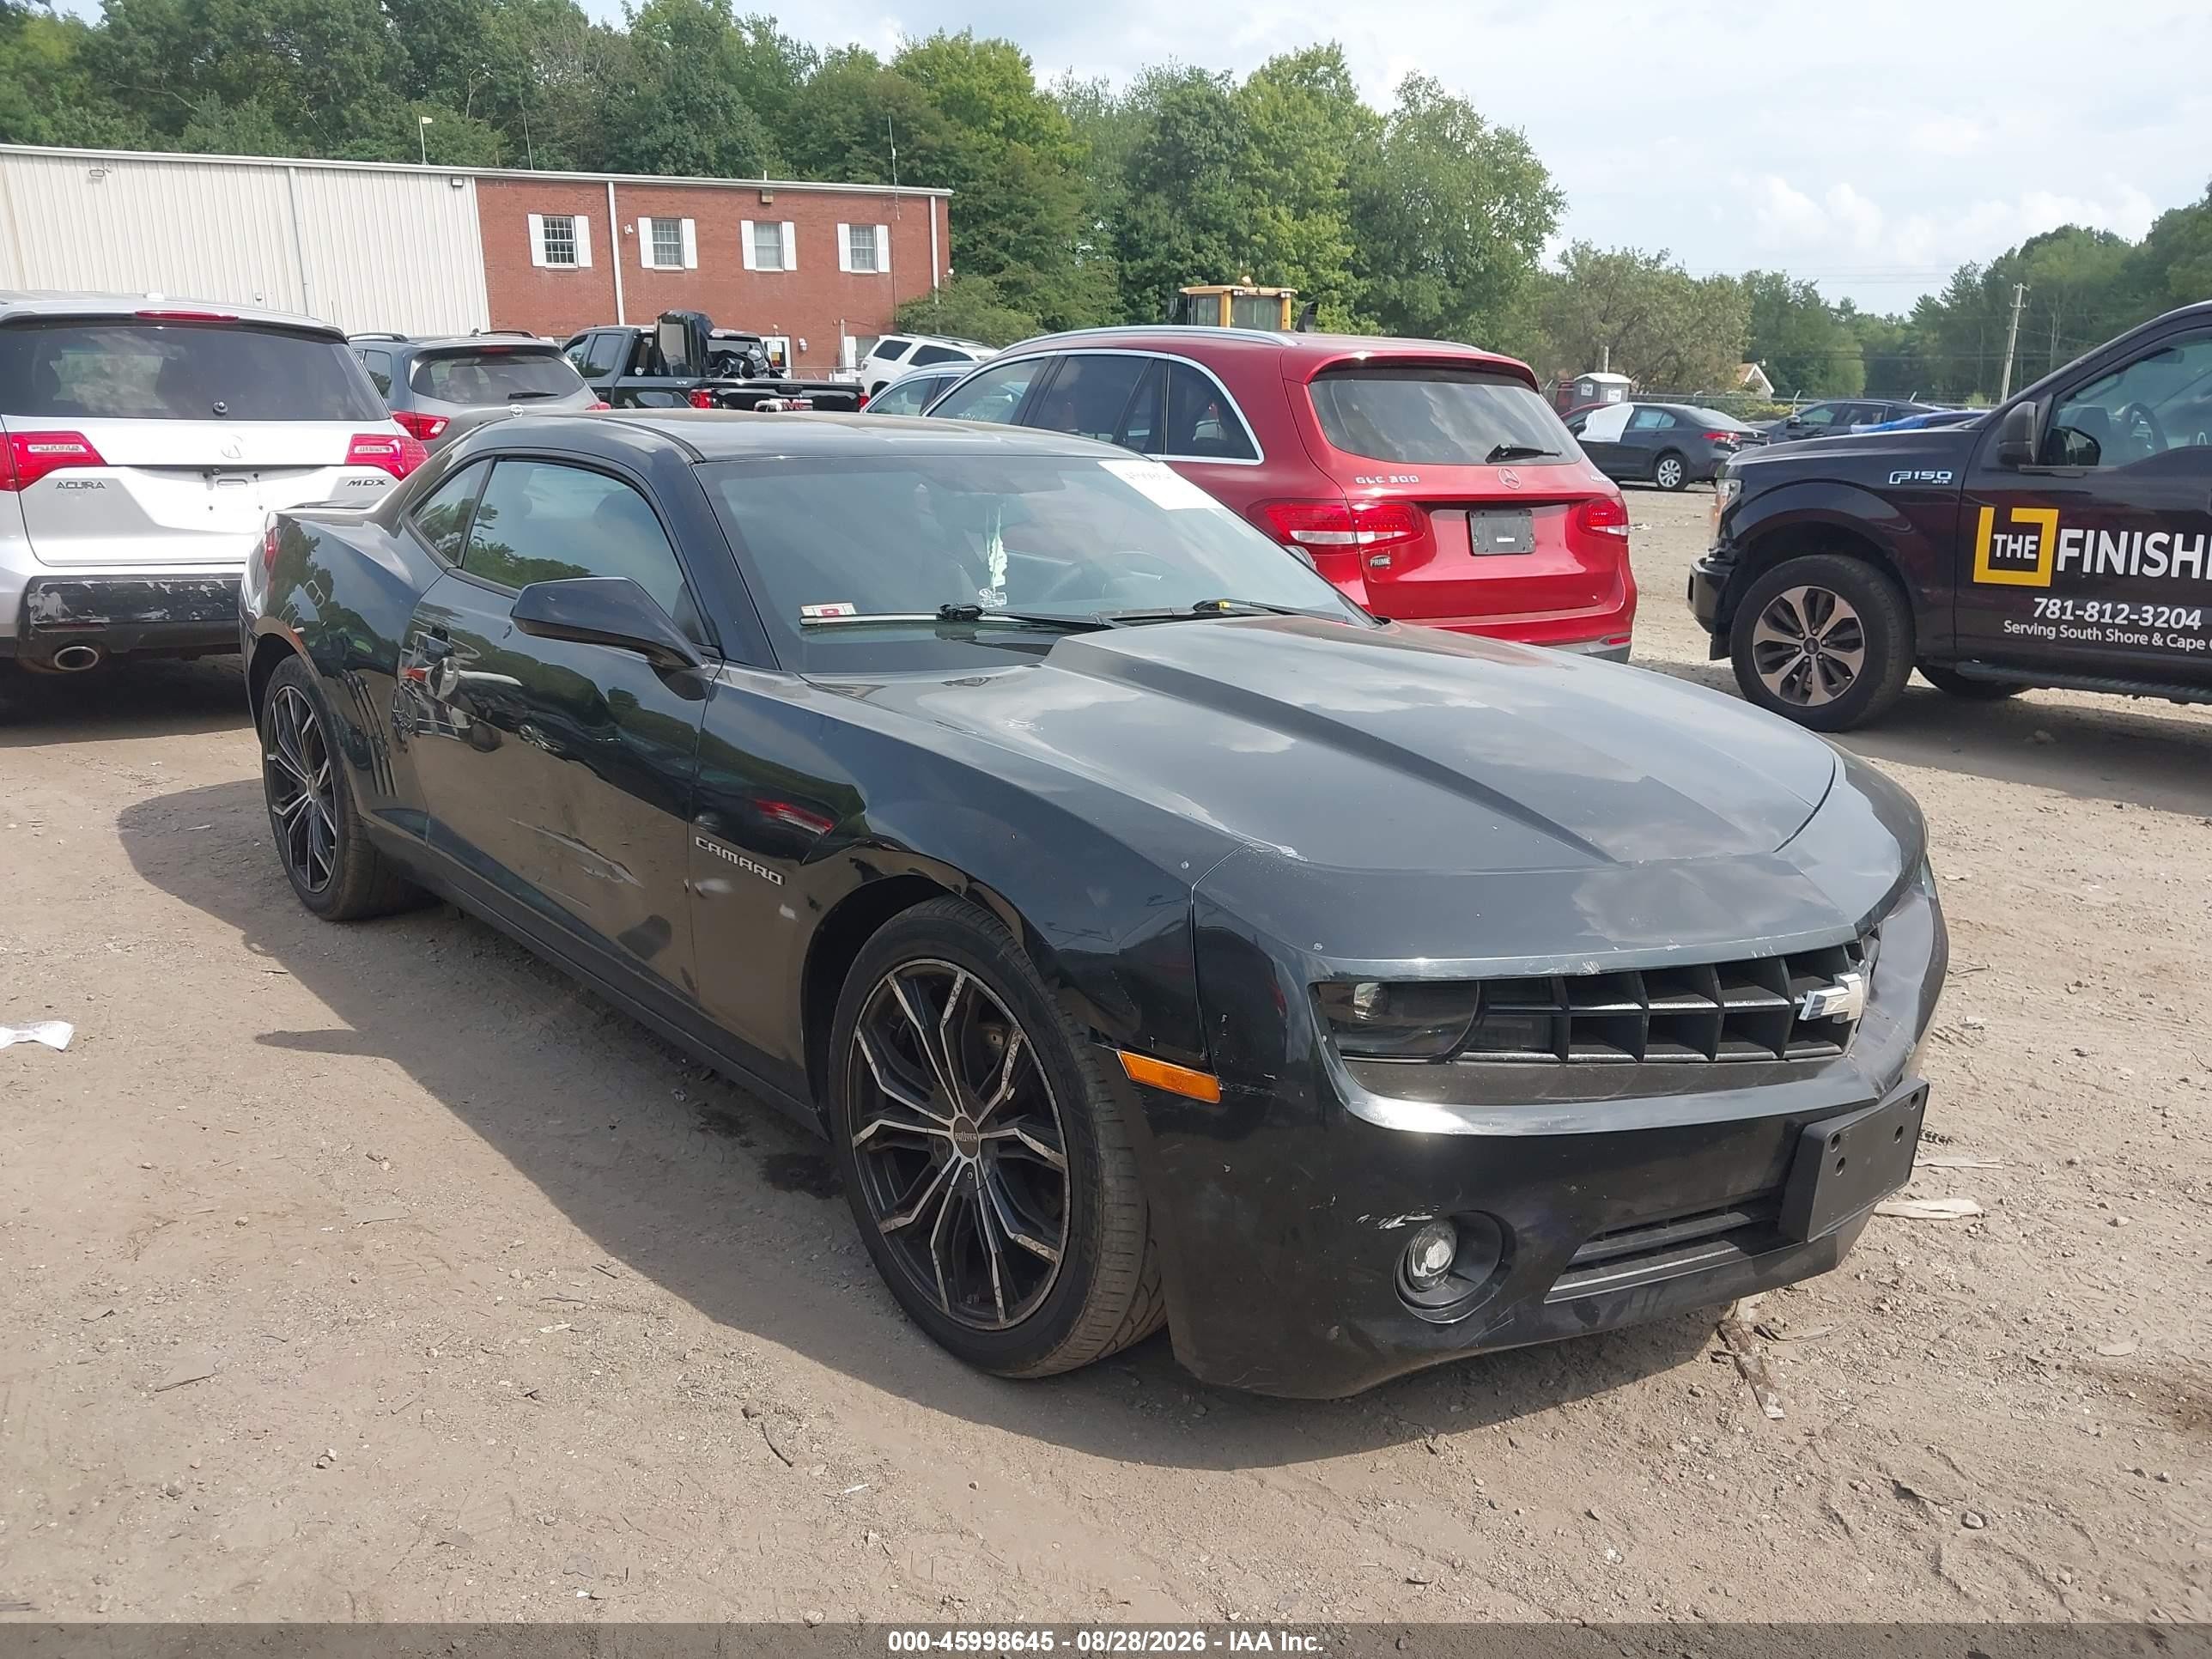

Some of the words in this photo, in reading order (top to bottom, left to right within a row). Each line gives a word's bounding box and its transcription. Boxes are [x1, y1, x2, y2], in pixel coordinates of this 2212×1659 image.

[55, 481, 106, 489] ACURA
[345, 478, 386, 487] MDX
[1388, 475, 1419, 483] 300
[1888, 471, 1953, 484] F150
[1993, 534, 2039, 559] THE
[2057, 529, 2212, 580] FINISH
[1370, 557, 1391, 567] PRIME
[2033, 598, 2202, 630] 781-812-3204
[2003, 620, 2057, 640] Serving
[2059, 624, 2102, 642] South
[2106, 629, 2148, 646] Shore
[2152, 632, 2164, 647] &
[2166, 634, 2206, 652] Cape
[696, 836, 783, 886] CAMARO
